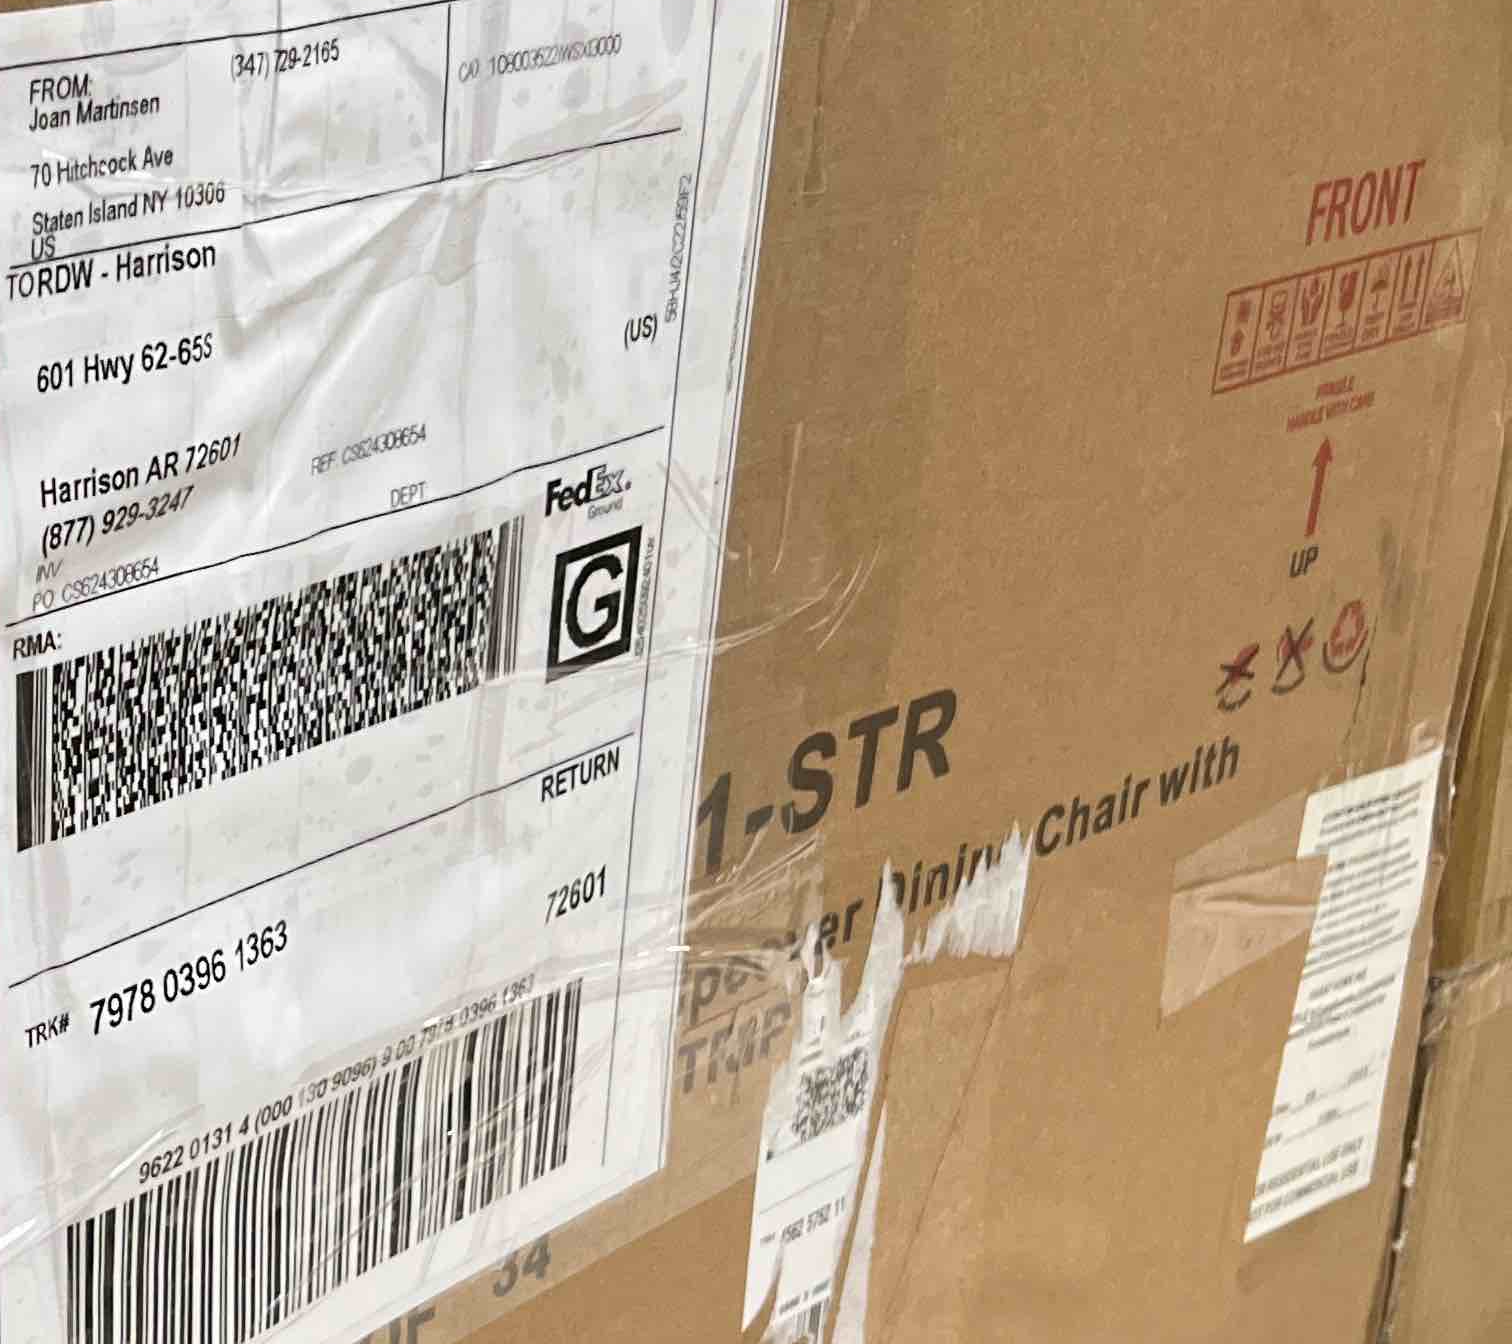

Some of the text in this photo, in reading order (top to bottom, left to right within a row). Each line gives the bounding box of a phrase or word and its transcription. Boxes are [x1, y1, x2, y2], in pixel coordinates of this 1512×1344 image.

[29, 74, 93, 106] FROM:
[231, 51, 270, 84] (347)
[274, 38, 340, 73] 729-2165
[29, 94, 161, 132] Joan Martinsen
[31, 145, 174, 189] 70 Hitchcock Ave
[32, 181, 226, 237] Staten Island NY 10306
[1305, 160, 1426, 247] FRONT
[31, 236, 57, 260] US
[116, 243, 216, 283] Harrison
[624, 313, 659, 350] (US)
[36, 359, 76, 393] 601
[84, 353, 135, 385] Hwy
[40, 432, 243, 509] Harrison AR 72601
[41, 485, 196, 559] (877) 929-3247
[1289, 545, 1319, 579] UP
[13, 630, 64, 659] RMA:
[539, 747, 622, 804] RETURN
[1035, 773, 1151, 857] Chair
[1159, 735, 1242, 809] with
[545, 864, 609, 926] 72601
[23, 920, 290, 1050] TRK# 7978 0396 1363
[139, 1144, 185, 1185] 9622
[189, 1121, 233, 1161] 0131
[238, 1113, 251, 1136] 4
[254, 1094, 294, 1135] (000
